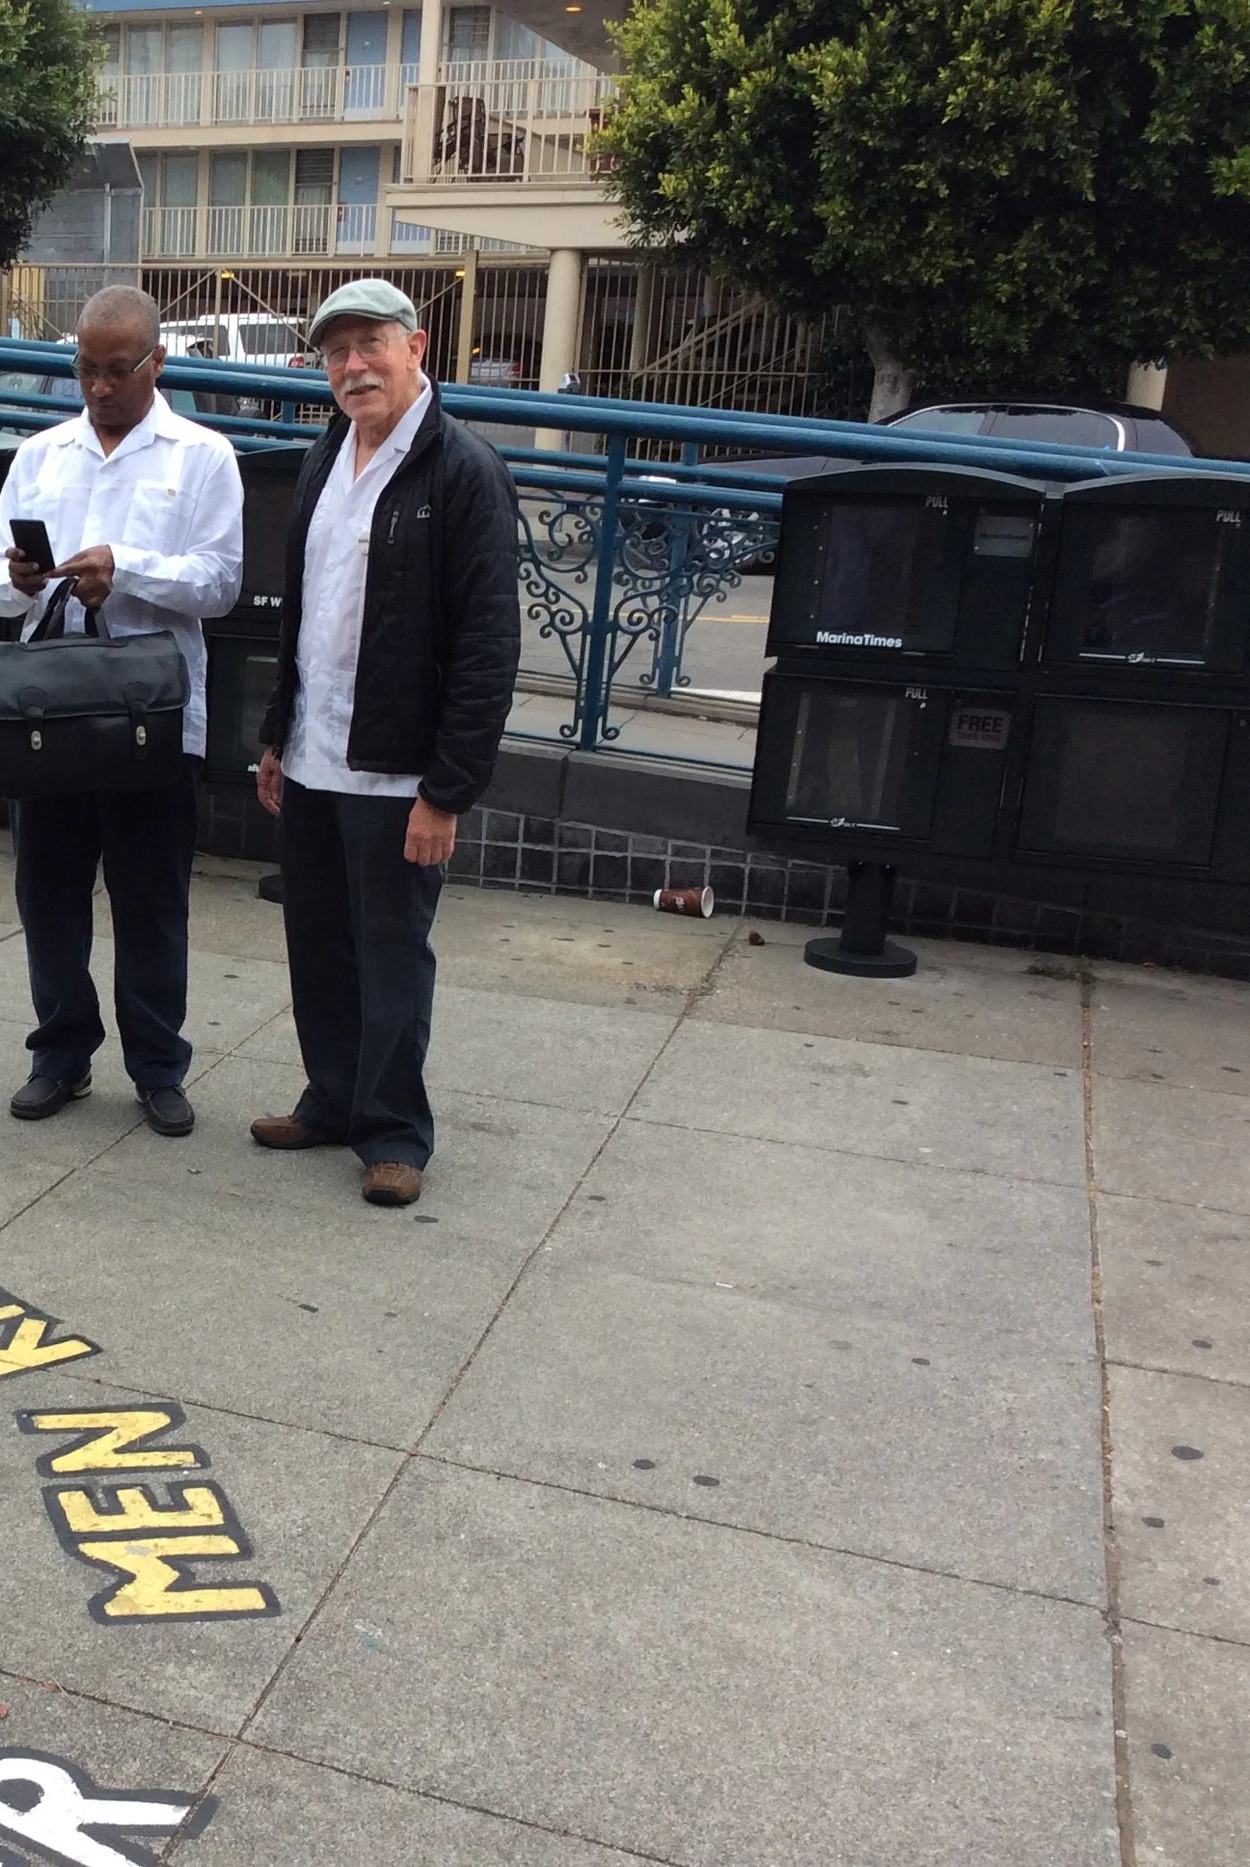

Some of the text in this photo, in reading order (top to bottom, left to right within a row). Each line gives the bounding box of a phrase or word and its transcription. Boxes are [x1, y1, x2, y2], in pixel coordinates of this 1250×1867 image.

[925, 496, 949, 508] PULL
[1216, 510, 1242, 523] PULL
[253, 595, 269, 606] SF
[816, 631, 902, 648] MarinaTimes
[905, 688, 928, 700] PULL
[957, 714, 1004, 734] FREE
[33, 1410, 268, 1617] MEN
